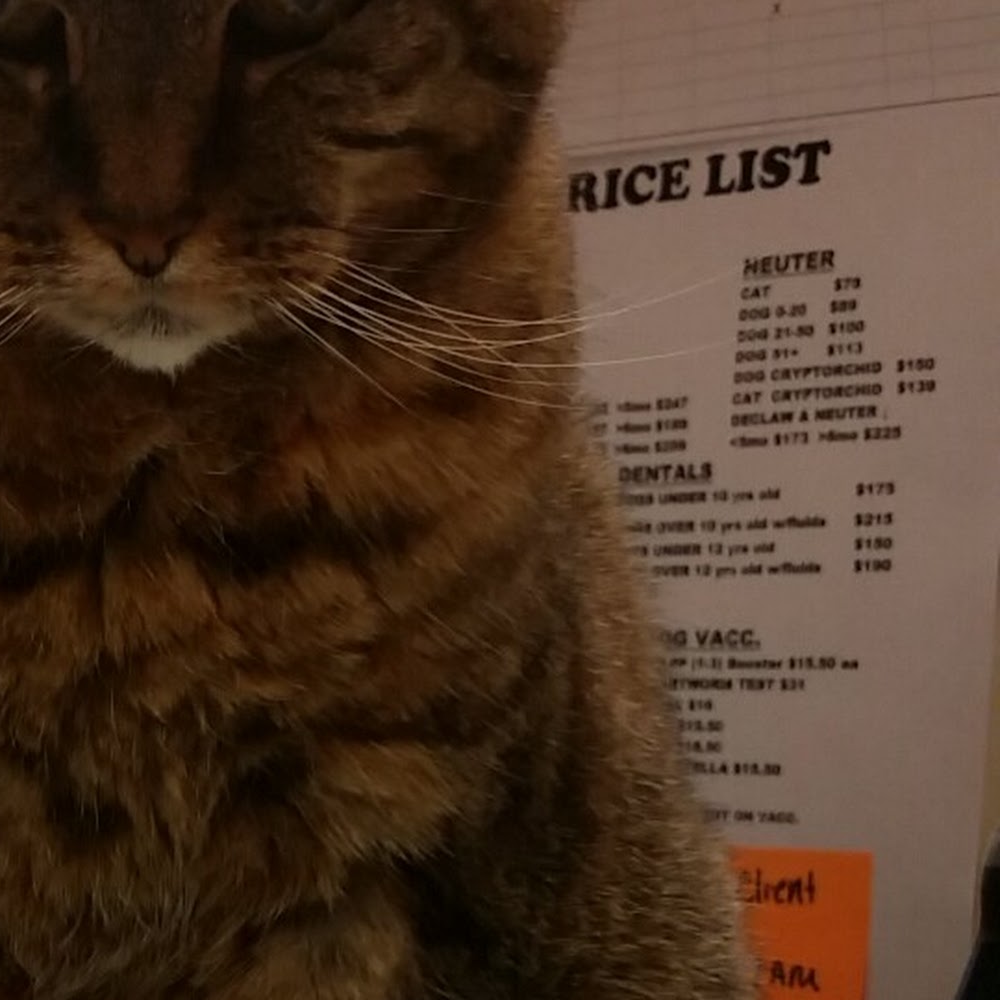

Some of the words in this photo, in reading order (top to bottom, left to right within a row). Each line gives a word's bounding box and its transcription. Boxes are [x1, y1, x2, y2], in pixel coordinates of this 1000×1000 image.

[566, 157, 691, 213] RICE
[704, 139, 832, 196] LIST
[740, 284, 772, 300] CAT
[738, 306, 770, 321] DOG
[736, 328, 768, 344] DOG
[735, 349, 766, 364] DOG
[733, 369, 765, 385] DOG
[769, 361, 883, 382] CRYPTORCHID
[731, 390, 763, 405] CAT
[770, 382, 883, 404] CRYPTORCHID
[730, 410, 794, 427] DECLAW
[814, 405, 878, 421] NEUTER
[617, 462, 713, 484] DENTALS
[758, 487, 781, 501] old
[746, 517, 768, 531] old
[753, 540, 776, 554] old
[740, 561, 763, 575] old
[657, 629, 687, 648] OG
[727, 656, 783, 671] Booster
